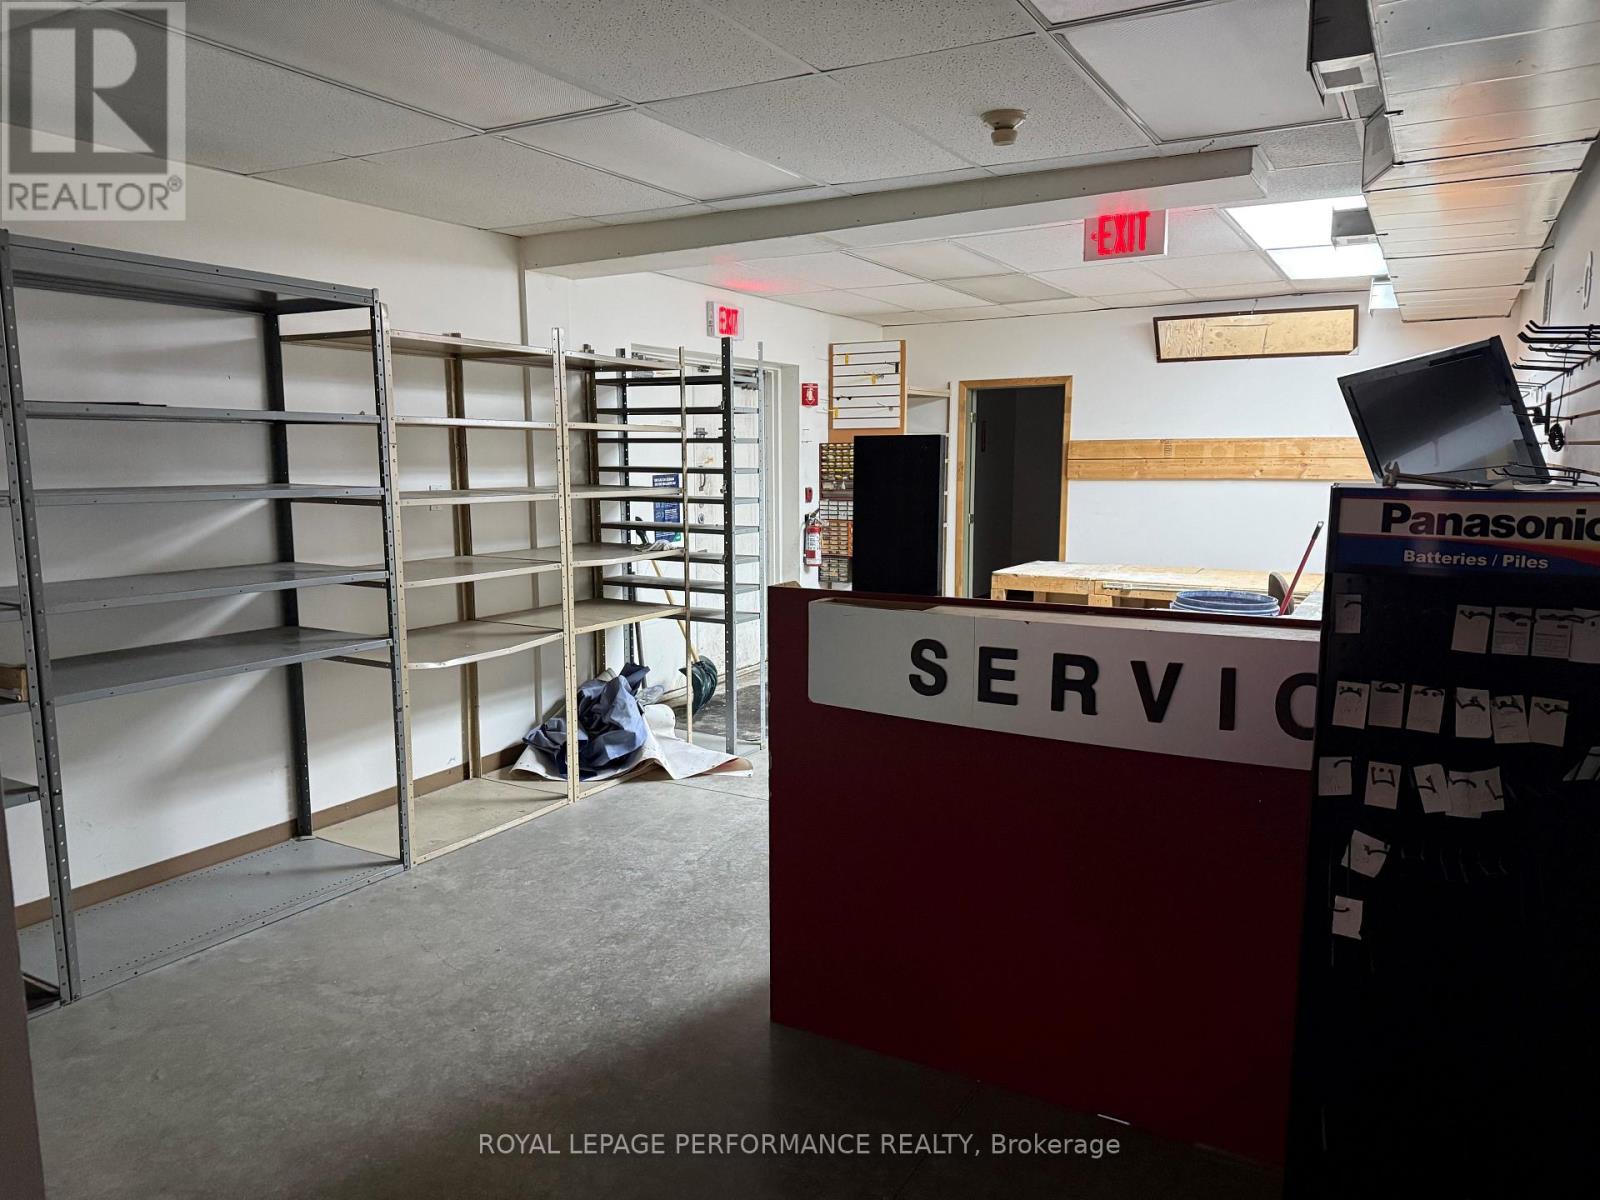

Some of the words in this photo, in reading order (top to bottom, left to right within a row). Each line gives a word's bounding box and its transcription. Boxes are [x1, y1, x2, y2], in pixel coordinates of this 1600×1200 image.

[1097, 211, 1151, 256] EXIT
[718, 306, 739, 336] EXIT
[1381, 502, 1600, 541] Panasonic
[1403, 549, 1488, 567] Batteries
[1503, 554, 1549, 569] Piles
